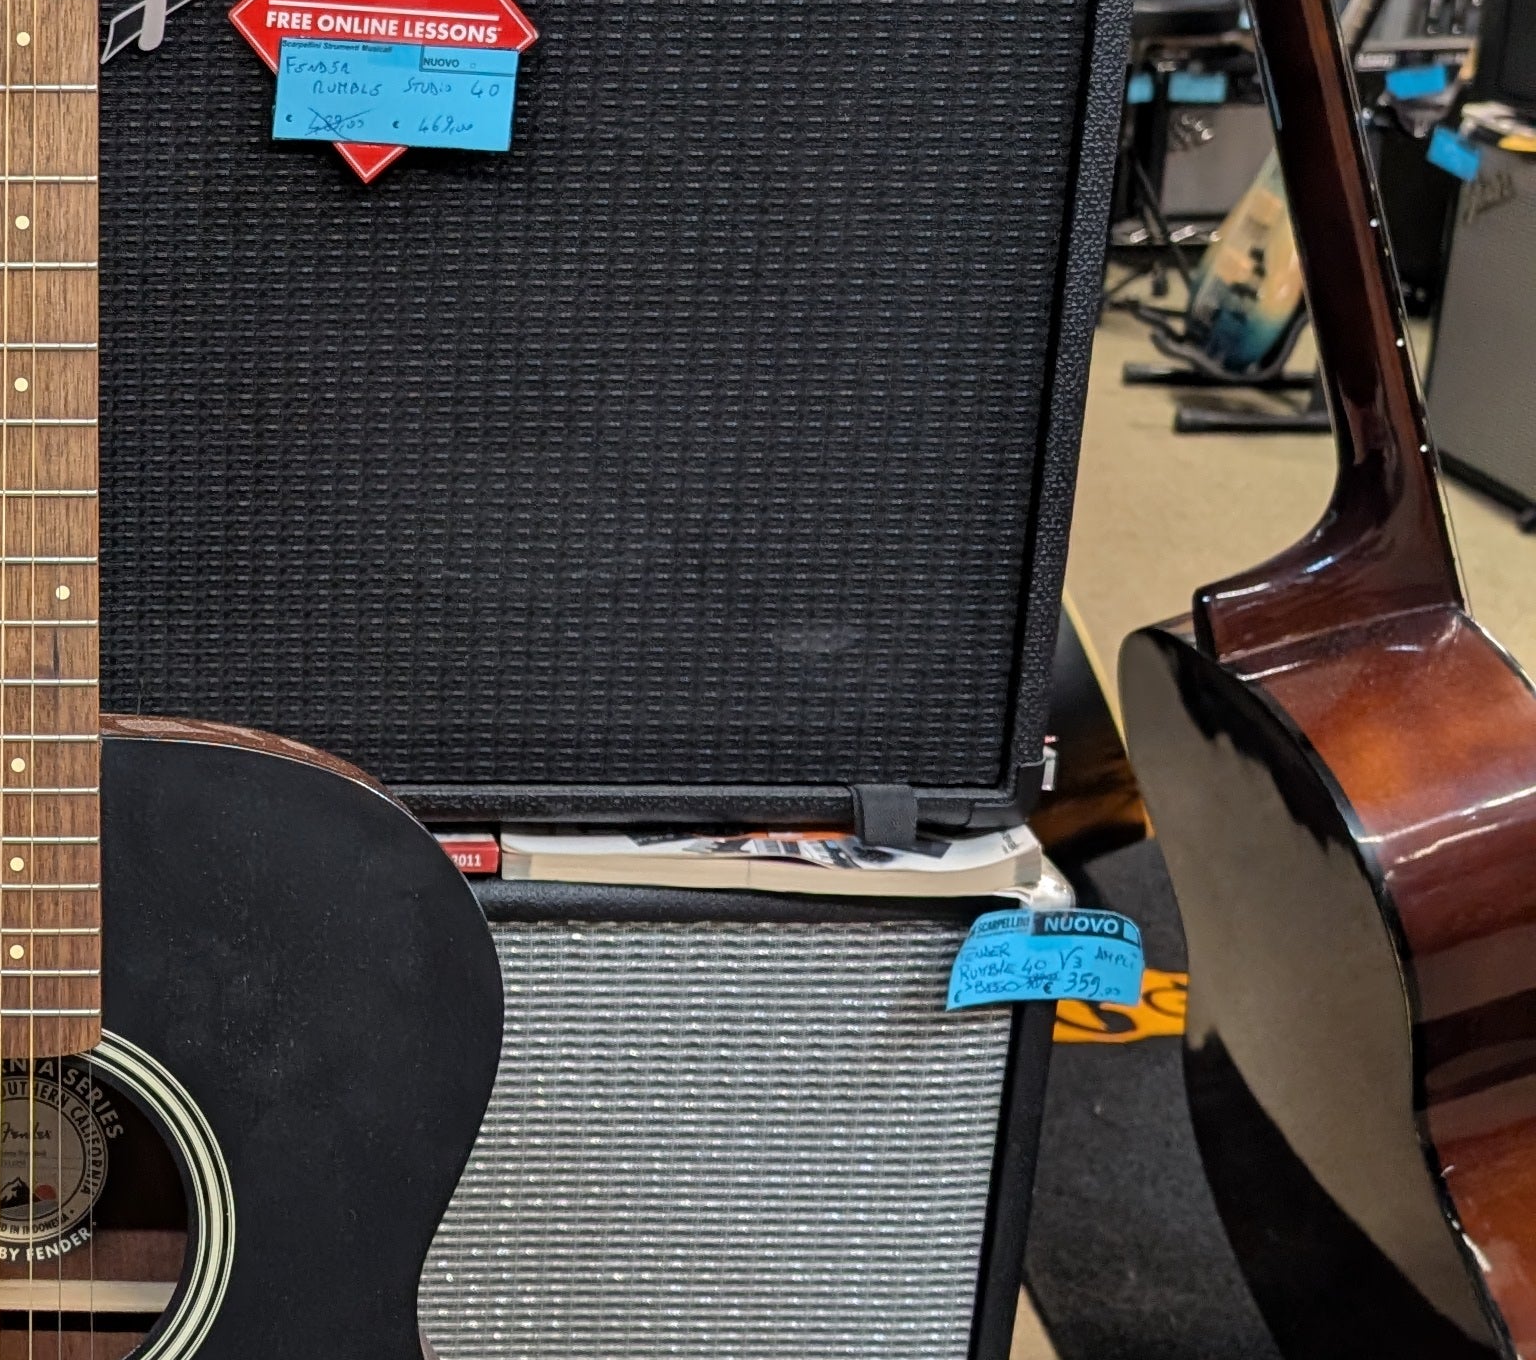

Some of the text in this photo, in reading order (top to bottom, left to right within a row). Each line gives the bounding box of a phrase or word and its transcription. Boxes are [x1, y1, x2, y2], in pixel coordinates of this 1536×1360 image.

[266, 11, 499, 44] FREE ONLINE LESSONS
[286, 56, 352, 75] FENDER
[423, 57, 460, 69] NUOVO
[1044, 917, 1119, 934] NUOVO
[63, 1069, 124, 1139] SERIES
[9, 1224, 20, 1235] IN
[22, 1212, 70, 1235] INDONESA
[27, 1227, 92, 1262] FENDER
